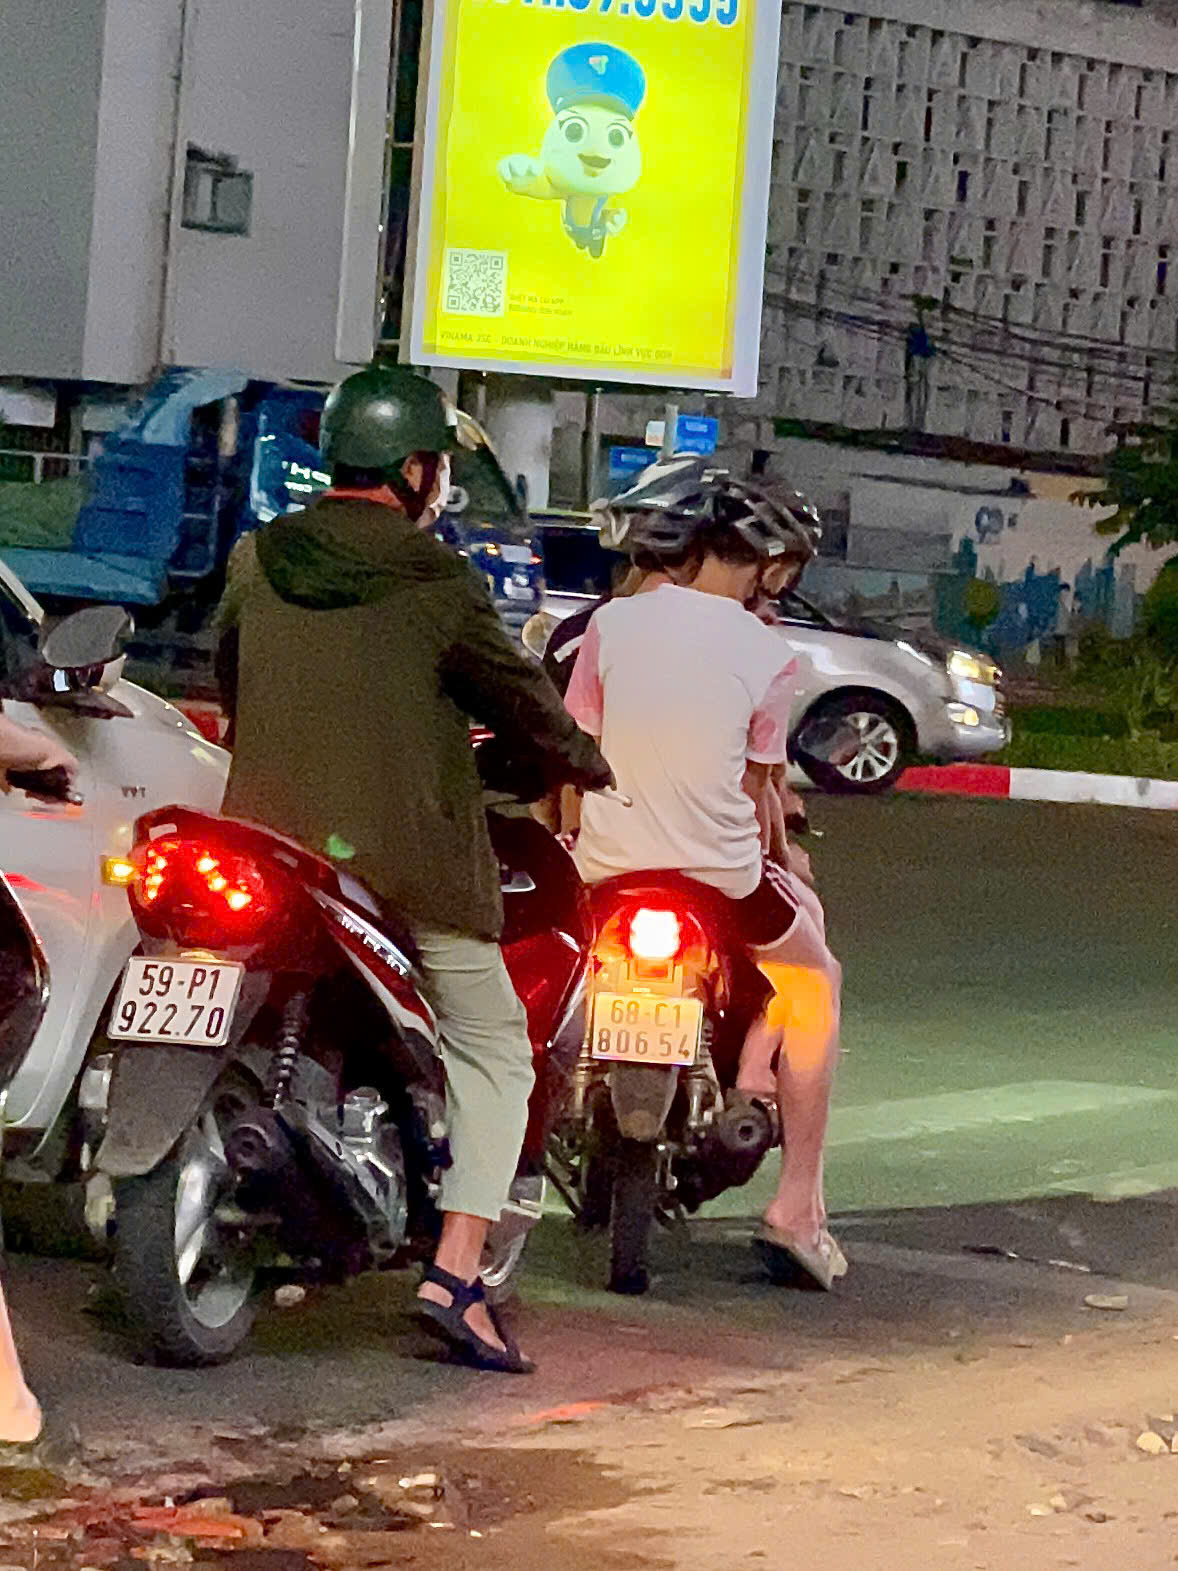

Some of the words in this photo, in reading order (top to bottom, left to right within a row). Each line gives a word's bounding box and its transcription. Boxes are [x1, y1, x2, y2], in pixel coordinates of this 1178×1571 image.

[139, 964, 221, 1000] 59-P1
[118, 1000, 225, 1038] 922.70
[611, 999, 681, 1028] 68-C1
